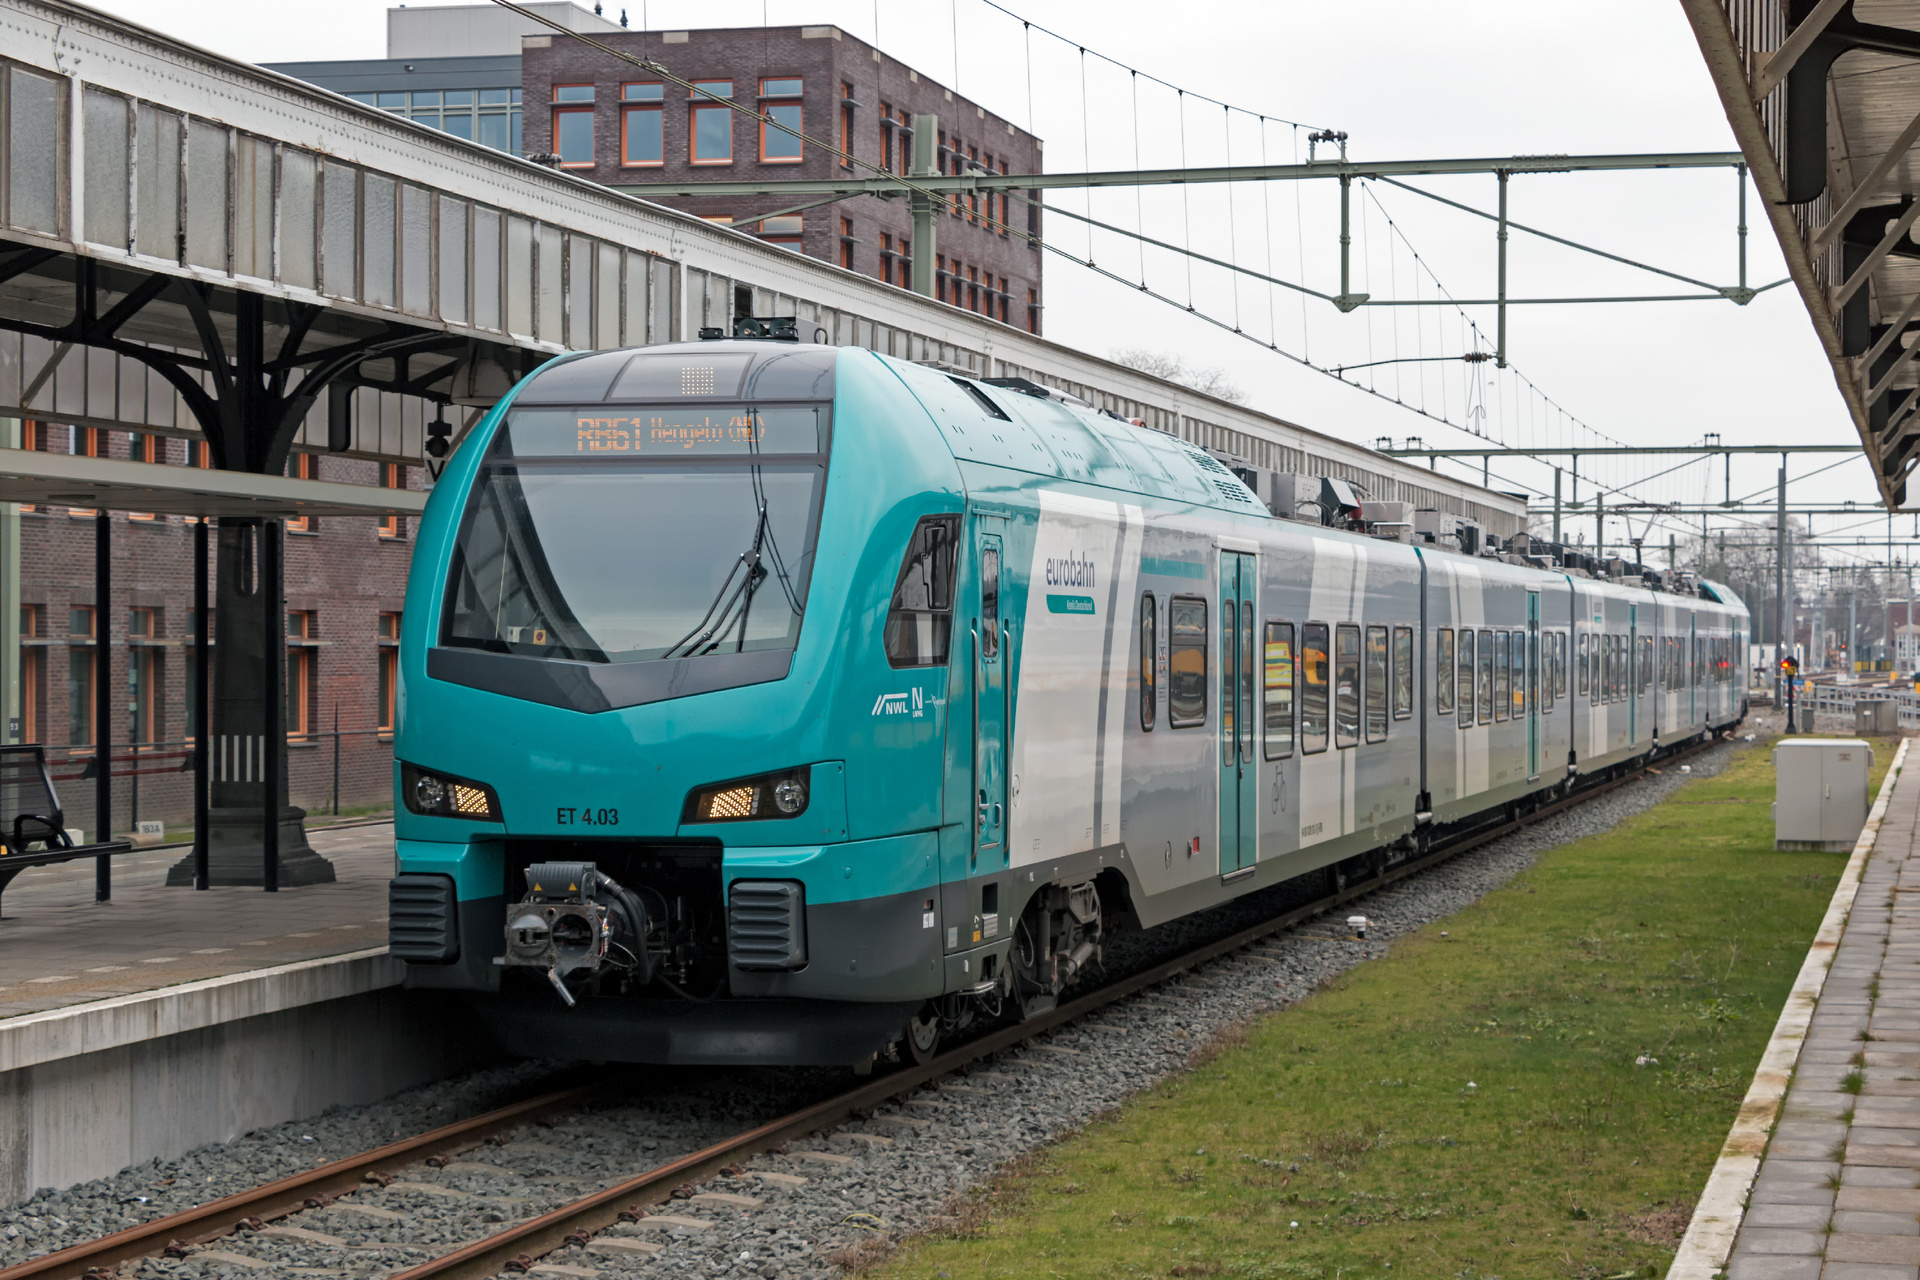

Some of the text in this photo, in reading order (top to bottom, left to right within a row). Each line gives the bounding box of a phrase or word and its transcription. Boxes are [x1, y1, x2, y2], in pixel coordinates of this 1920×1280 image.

[577, 418, 641, 451] RB61
[651, 416, 723, 449] Hengelo
[1046, 549, 1095, 588] eurobahn
[885, 701, 909, 715] NWL
[557, 807, 619, 826] ET 4.03
